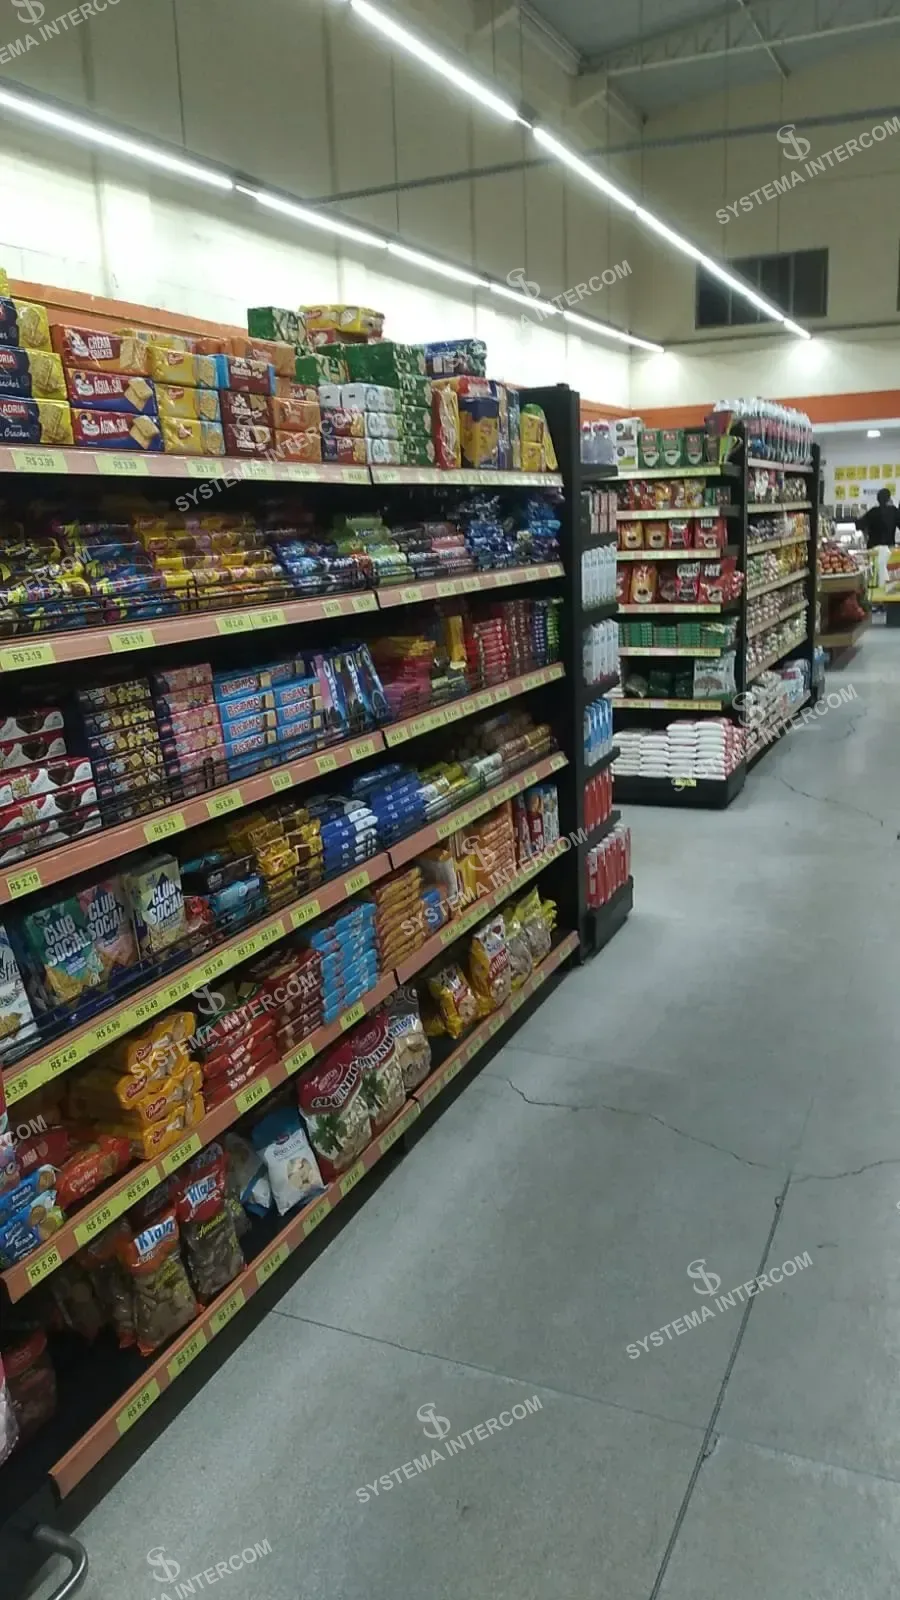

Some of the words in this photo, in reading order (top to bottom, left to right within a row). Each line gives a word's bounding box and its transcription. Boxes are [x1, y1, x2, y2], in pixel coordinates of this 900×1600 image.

[88, 336, 111, 349] CREAM
[3, 404, 25, 414] ADRIA
[12, 653, 25, 664] R$
[9, 882, 21, 893] R$
[152, 881, 176, 905] CLUB
[88, 892, 117, 919] CLUB
[44, 913, 77, 946] CLUB
[169, 989, 178, 999] R$
[135, 1007, 145, 1018] R$
[96, 1029, 106, 1040] R$
[50, 1059, 62, 1071] R$
[312, 1062, 358, 1108] COQUINHO
[171, 1152, 181, 1163] R$
[127, 1187, 137, 1200] R$
[86, 1220, 96, 1233] R$
[30, 1266, 41, 1280] R$
[128, 1405, 137, 1420] R$
